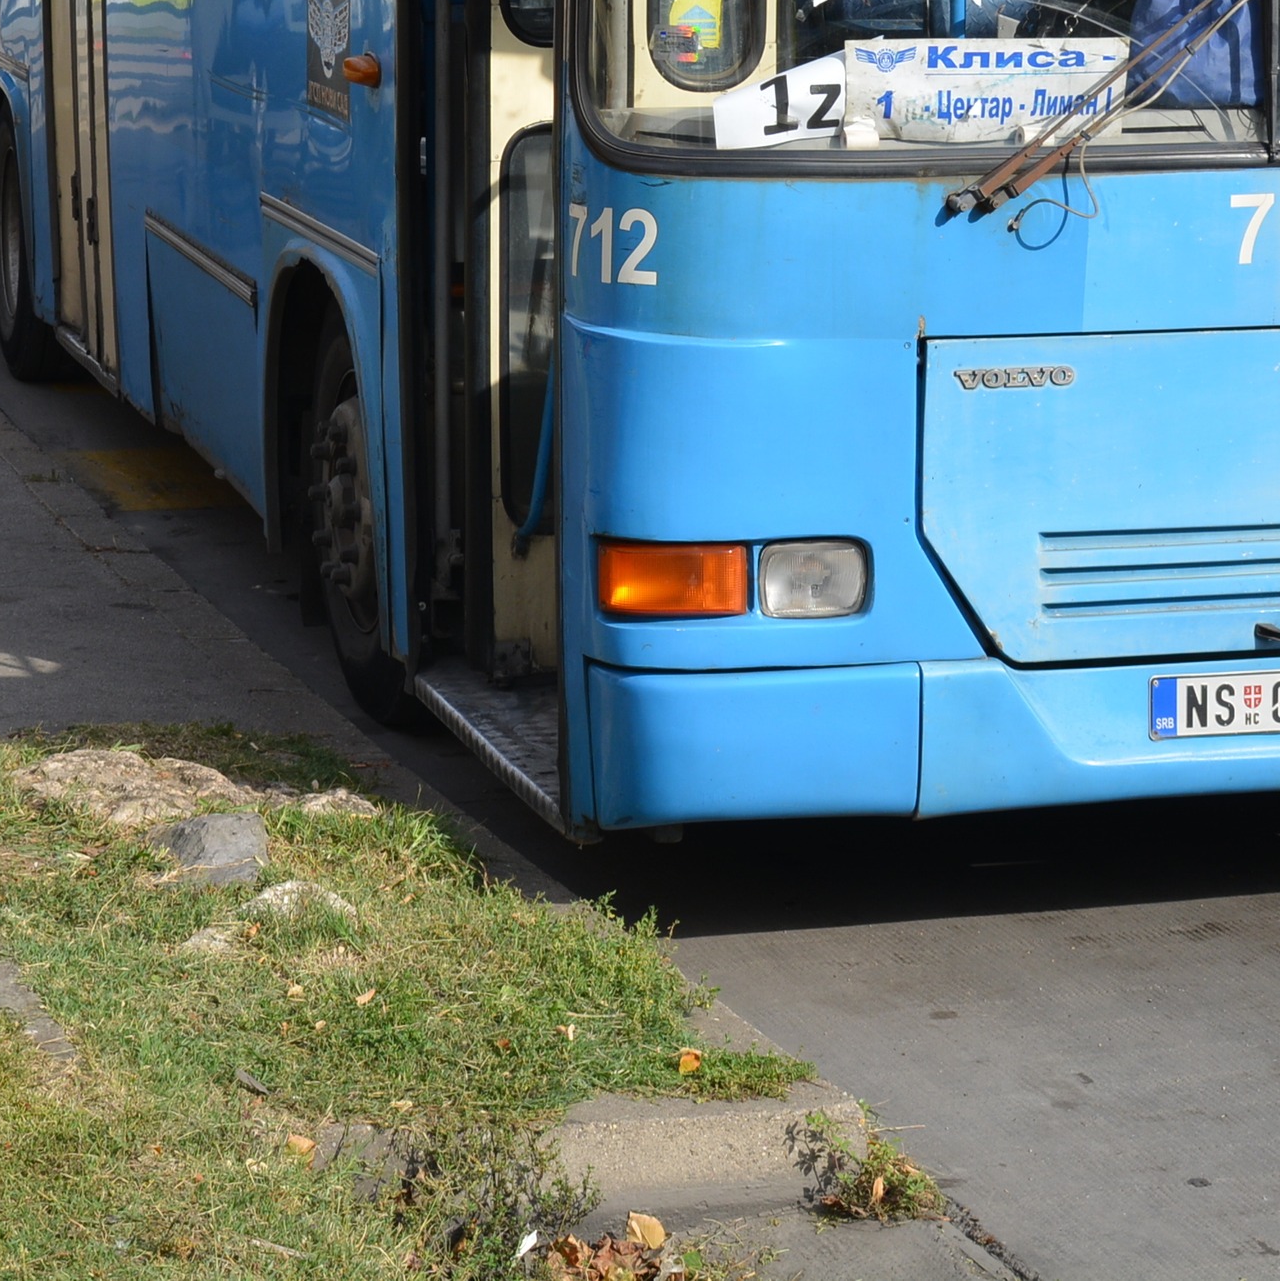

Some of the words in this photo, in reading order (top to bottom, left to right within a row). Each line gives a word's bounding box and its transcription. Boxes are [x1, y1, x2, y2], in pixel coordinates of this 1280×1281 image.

[926, 45, 1086, 69] Клиса
[876, 90, 895, 119] 1
[568, 202, 658, 286] 712
[953, 365, 1075, 390] VOLVO
[1185, 683, 1236, 729] NS
[1155, 717, 1176, 730] SRB
